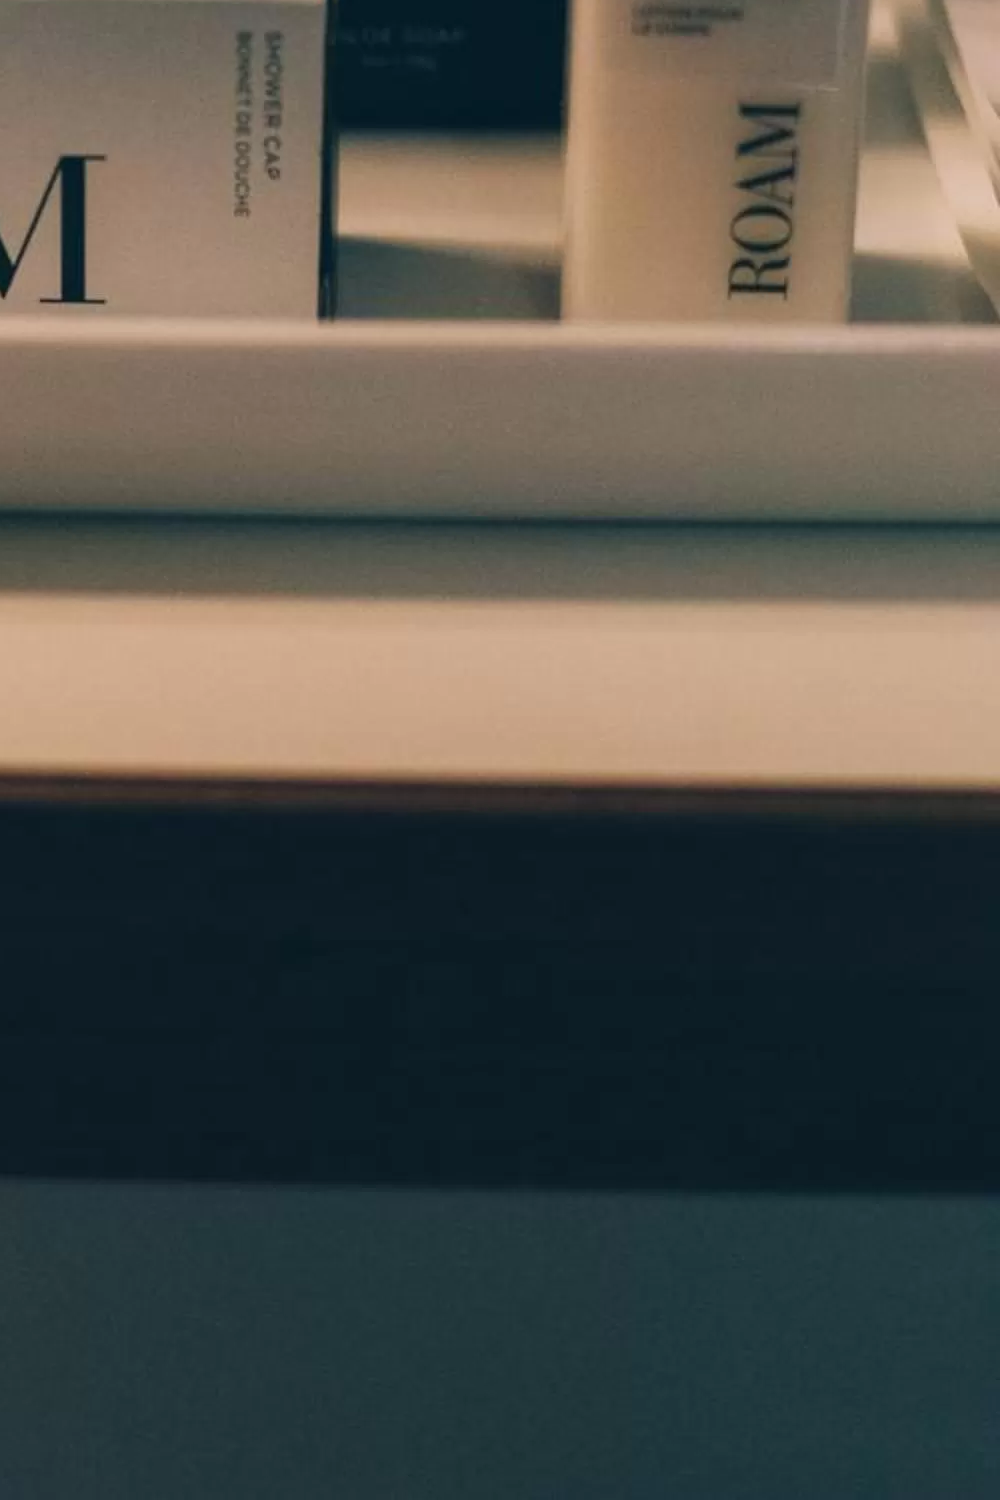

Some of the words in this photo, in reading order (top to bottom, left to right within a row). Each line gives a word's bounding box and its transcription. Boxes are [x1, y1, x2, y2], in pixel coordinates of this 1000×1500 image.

[264, 30, 283, 128] SHOWER
[235, 111, 251, 136] DE
[263, 135, 281, 181] CAP
[234, 140, 251, 218] DOUCHE
[727, 102, 801, 301] ROAM
